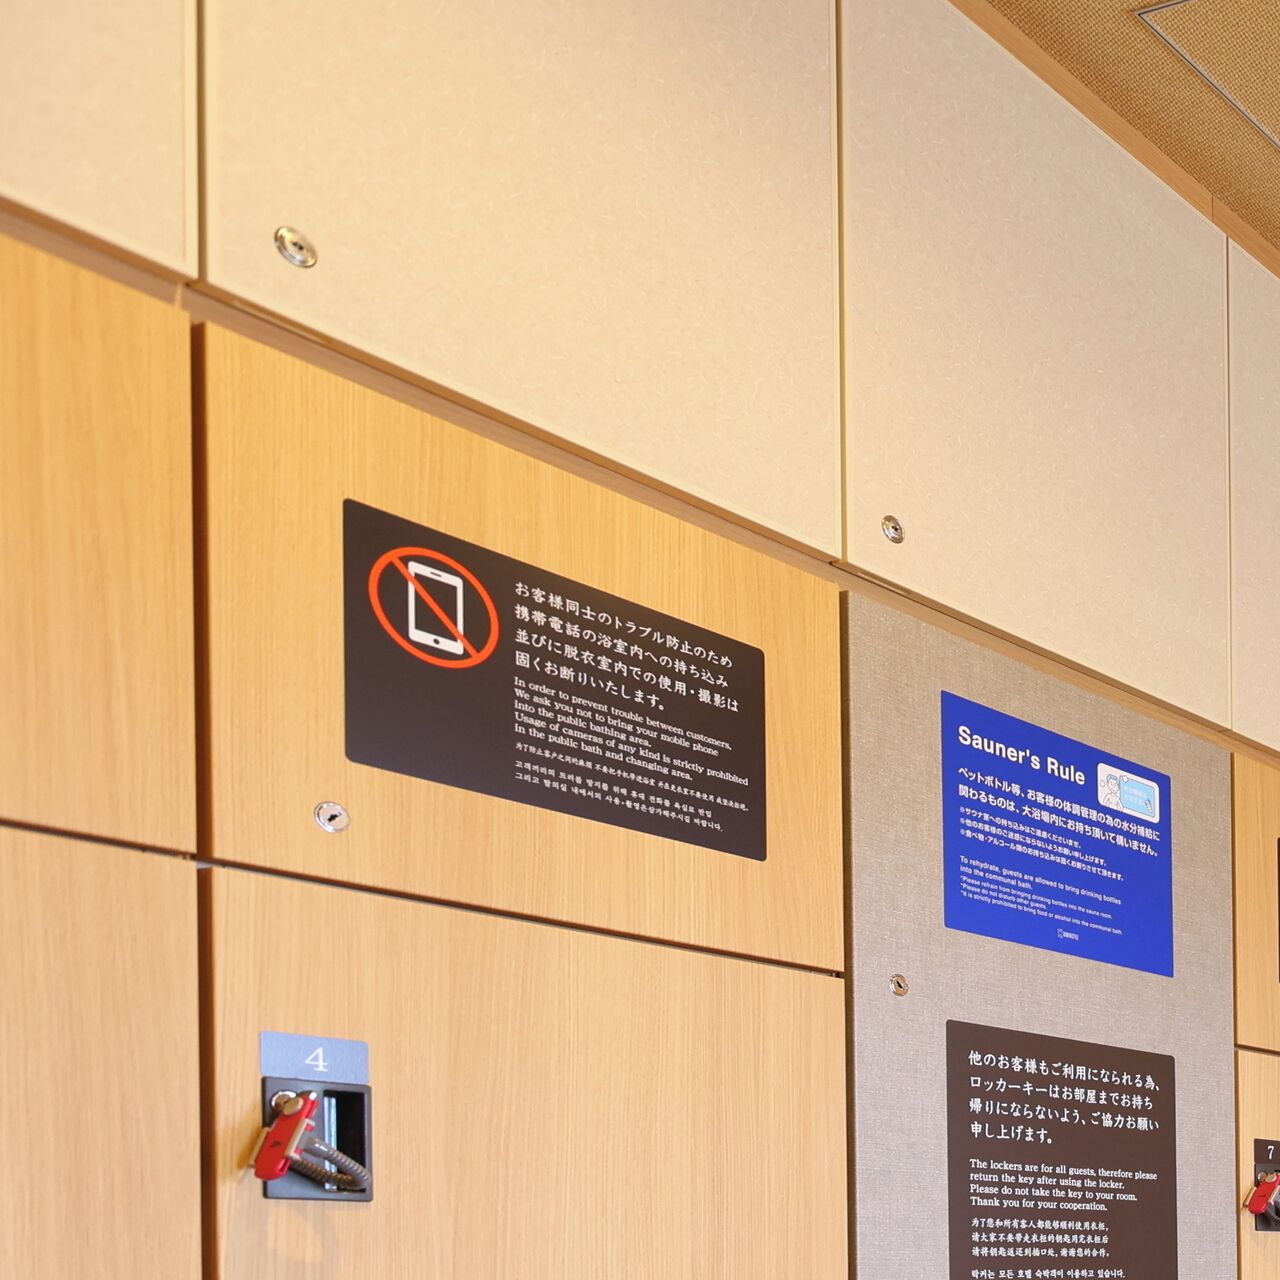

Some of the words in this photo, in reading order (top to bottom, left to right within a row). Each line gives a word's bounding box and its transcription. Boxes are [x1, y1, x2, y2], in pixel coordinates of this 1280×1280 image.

[514, 604, 728, 688] 携帯電話の浴室内への持ち込み
[515, 582, 732, 668] お客様同士のトラブル防止のため
[515, 629, 739, 712] 並びに脱衣室内での使用・撮影は
[515, 650, 664, 710] 固くお断りいたします。
[514, 676, 525, 688] In
[528, 683, 555, 697] order
[558, 689, 569, 701] to
[571, 696, 607, 712] prevent
[610, 705, 643, 722] trouble
[646, 715, 683, 734] between
[686, 729, 732, 749] customers,
[515, 688, 529, 700] We
[533, 696, 550, 706] ask
[554, 702, 572, 713] you
[576, 708, 591, 718] not
[595, 711, 604, 722] to
[607, 715, 632, 733] bring
[636, 726, 656, 737] your
[661, 733, 689, 747] mobile
[693, 741, 718, 756] phone
[538, 707, 553, 719] the
[557, 715, 586, 729] public
[590, 721, 626, 742] bathing
[629, 735, 651, 747] area.
[514, 711, 546, 729] Usage
[548, 722, 559, 732] of
[561, 727, 603, 744] cameras
[605, 738, 615, 748] of
[617, 742, 636, 756] any
[639, 746, 660, 760] kind
[662, 752, 670, 763] is
[672, 756, 704, 775] strictly
[706, 767, 748, 785] prohibited
[529, 727, 544, 740] the
[548, 735, 577, 749] public
[581, 741, 602, 755] bath
[605, 750, 623, 761] and
[625, 755, 668, 775] changing
[671, 768, 692, 780] area.
[958, 726, 1041, 770] Sauner's
[1047, 757, 1085, 785] Rule
[958, 767, 1160, 841] ペットボトル等、お客様の体調管理の為の水分補給に
[959, 784, 1158, 856] 関わるものは、大浴場内にお持ち頂いて構いません。
[304, 1048, 328, 1072] 4
[968, 1051, 1159, 1091] 他のお客様もご利用になられる為、
[969, 1098, 1159, 1131] 帰りにならないよう、ご協力お願い
[970, 1076, 1153, 1110] ロッカーキーはお部屋までお持ち
[970, 1121, 1052, 1144] 申し上げます。
[1268, 1146, 1274, 1160] 7
[969, 1173, 998, 1182] return
[1001, 1174, 1015, 1183] the
[1018, 1175, 1033, 1186] key
[1036, 1176, 1056, 1185] after
[1059, 1178, 1081, 1188] using
[1084, 1179, 1096, 1187] the
[1099, 1180, 1124, 1188] locker.
[969, 1184, 998, 1194] Please
[1000, 1186, 1012, 1194] do
[1014, 1187, 1029, 1195] not
[1031, 1188, 1049, 1196] take
[1052, 1189, 1065, 1197] the
[1067, 1189, 1083, 1200] key
[1085, 1190, 1093, 1198] to
[970, 1159, 987, 1169] The
[990, 1161, 1022, 1171] lockers
[1040, 1164, 1053, 1173] for
[1055, 1165, 1066, 1174] all
[1068, 1167, 1096, 1176] guests,
[1098, 1168, 1132, 1178] therefore
[1134, 1170, 1157, 1180] please
[970, 1197, 1000, 1207] Thank
[1002, 1201, 1019, 1209] you
[1022, 1199, 1034, 1208] for
[1037, 1202, 1057, 1210] your
[1059, 1202, 1107, 1211] cooperation.
